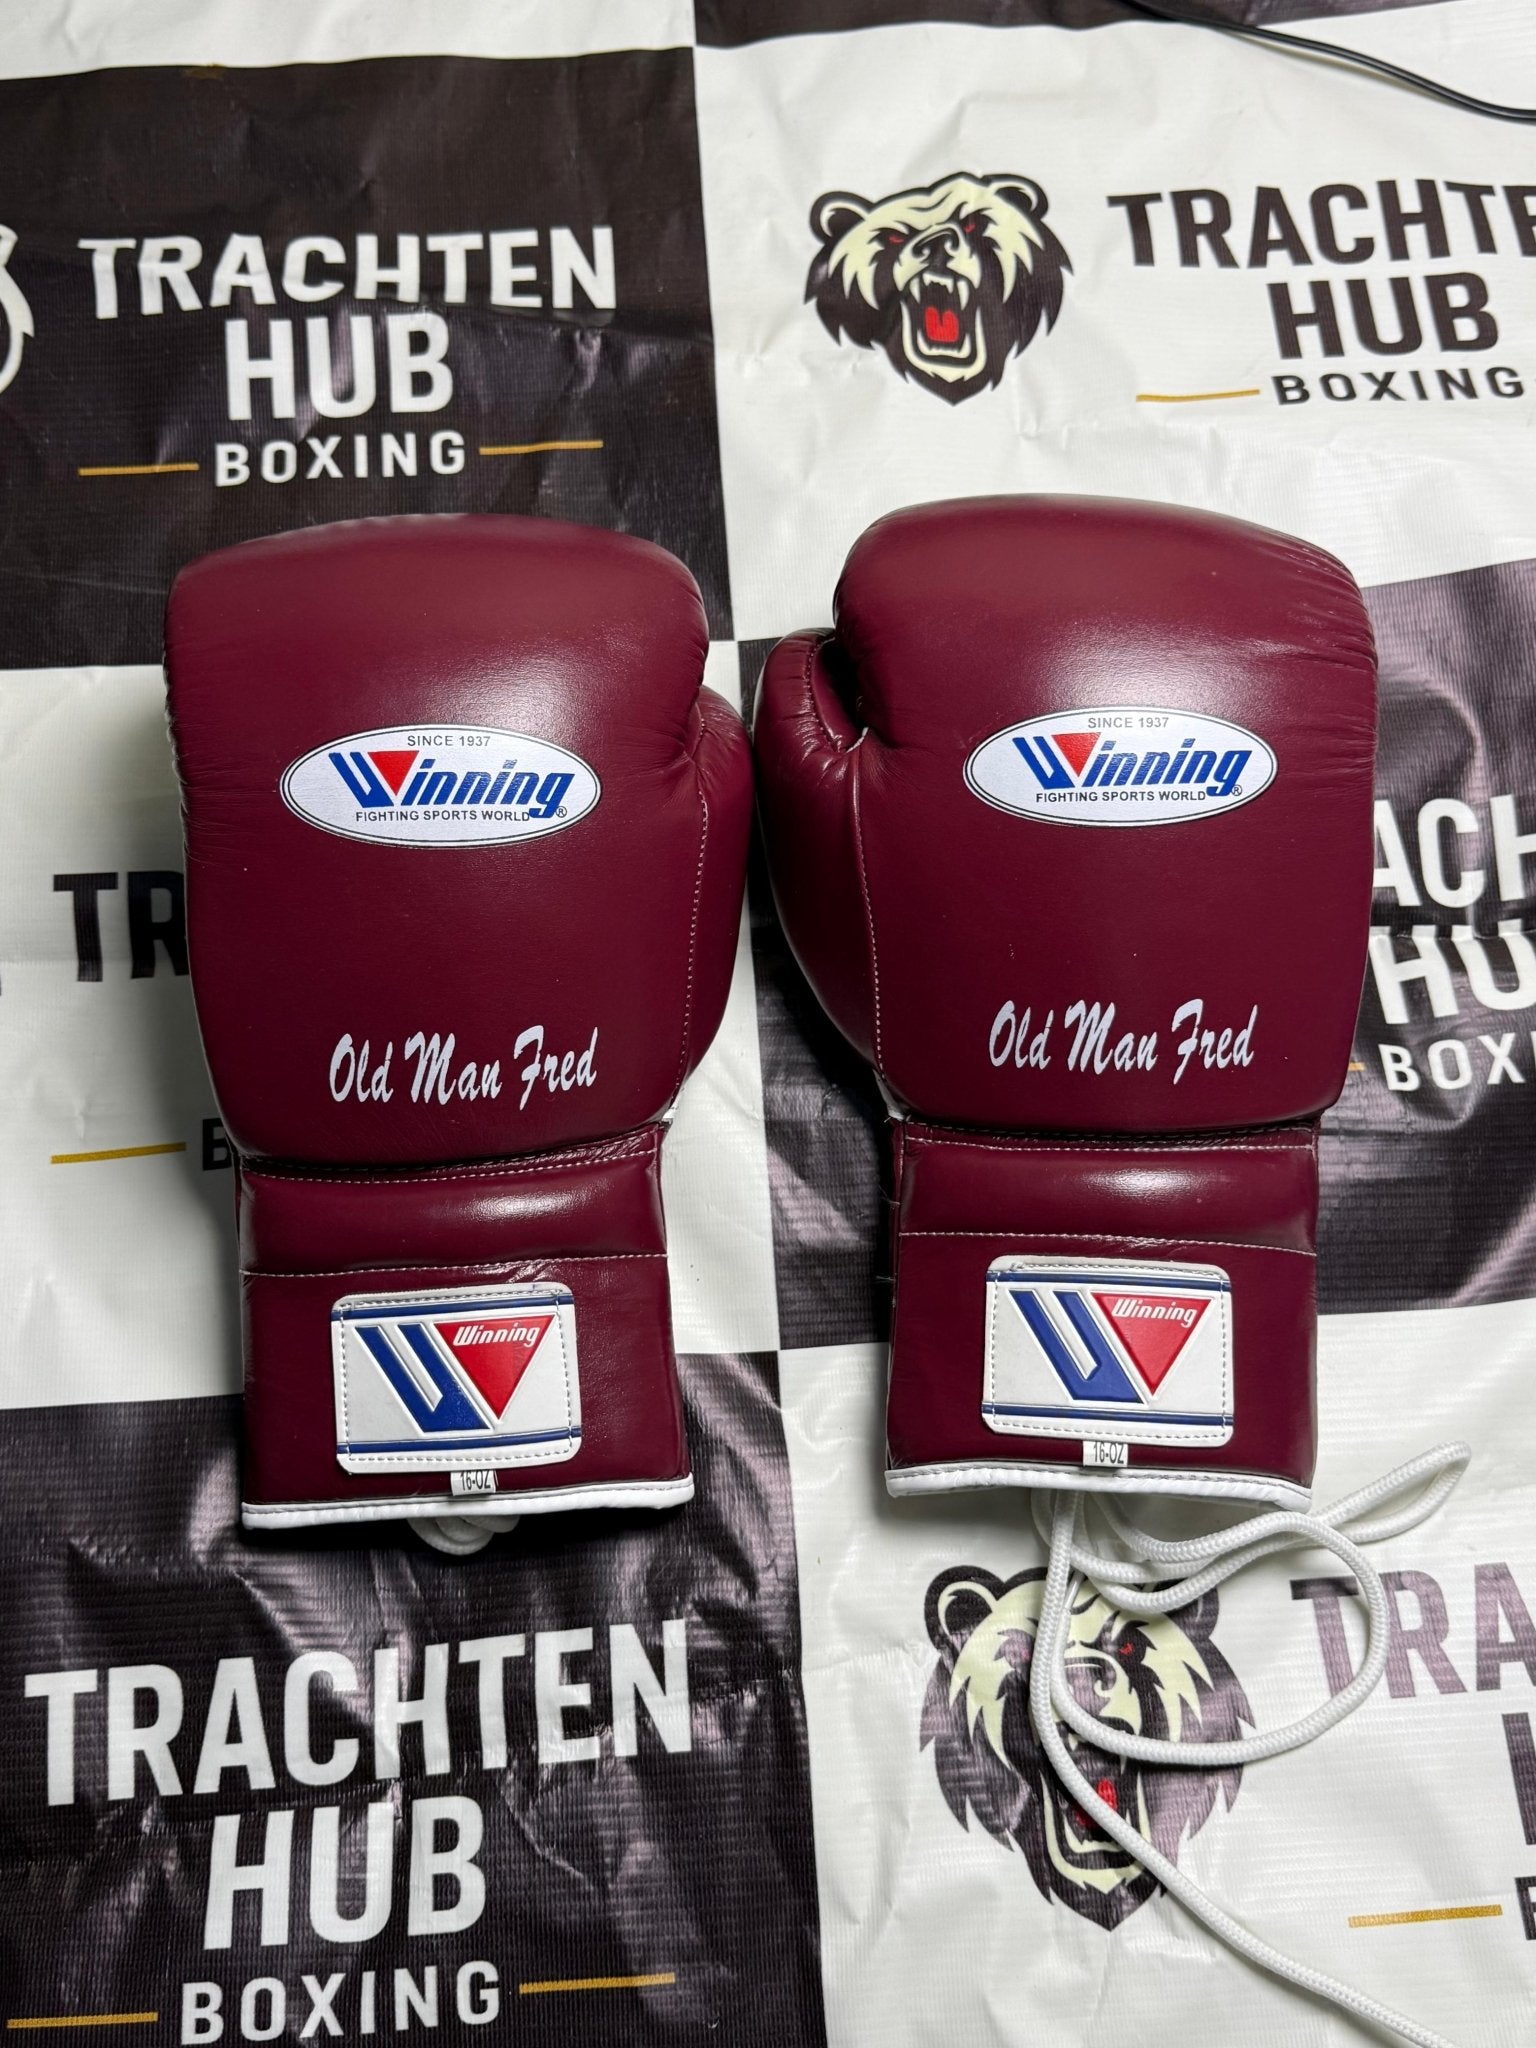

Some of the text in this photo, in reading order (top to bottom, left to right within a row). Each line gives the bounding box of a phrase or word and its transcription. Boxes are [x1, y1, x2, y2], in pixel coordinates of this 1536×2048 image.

[77, 226, 617, 319] TRACHTEN
[1266, 272, 1499, 359] HUB
[225, 312, 454, 420] HUB
[1271, 366, 1525, 405] BOXING
[215, 430, 465, 487] BOXING
[407, 735, 491, 747] SINCE 1937
[1087, 716, 1169, 729] SINCE 1937
[328, 750, 575, 819] Winning
[1012, 731, 1252, 797] Winning
[356, 810, 530, 823] FIGHTING SPORTS WORLD
[1036, 790, 1206, 803] FIGHTING SPORTS WORLD
[329, 1025, 598, 1110] Old Man Fred
[989, 999, 1258, 1084] Old Man Fred
[452, 1322, 541, 1348] Winning
[1111, 1297, 1197, 1329] Winning
[460, 1469, 492, 1491] 16-OZ
[1093, 1442, 1125, 1464] 16-OZ
[24, 1619, 693, 1806] TRACHTEN
[203, 1795, 487, 1951] HUB
[180, 1960, 501, 2046] BOXING
